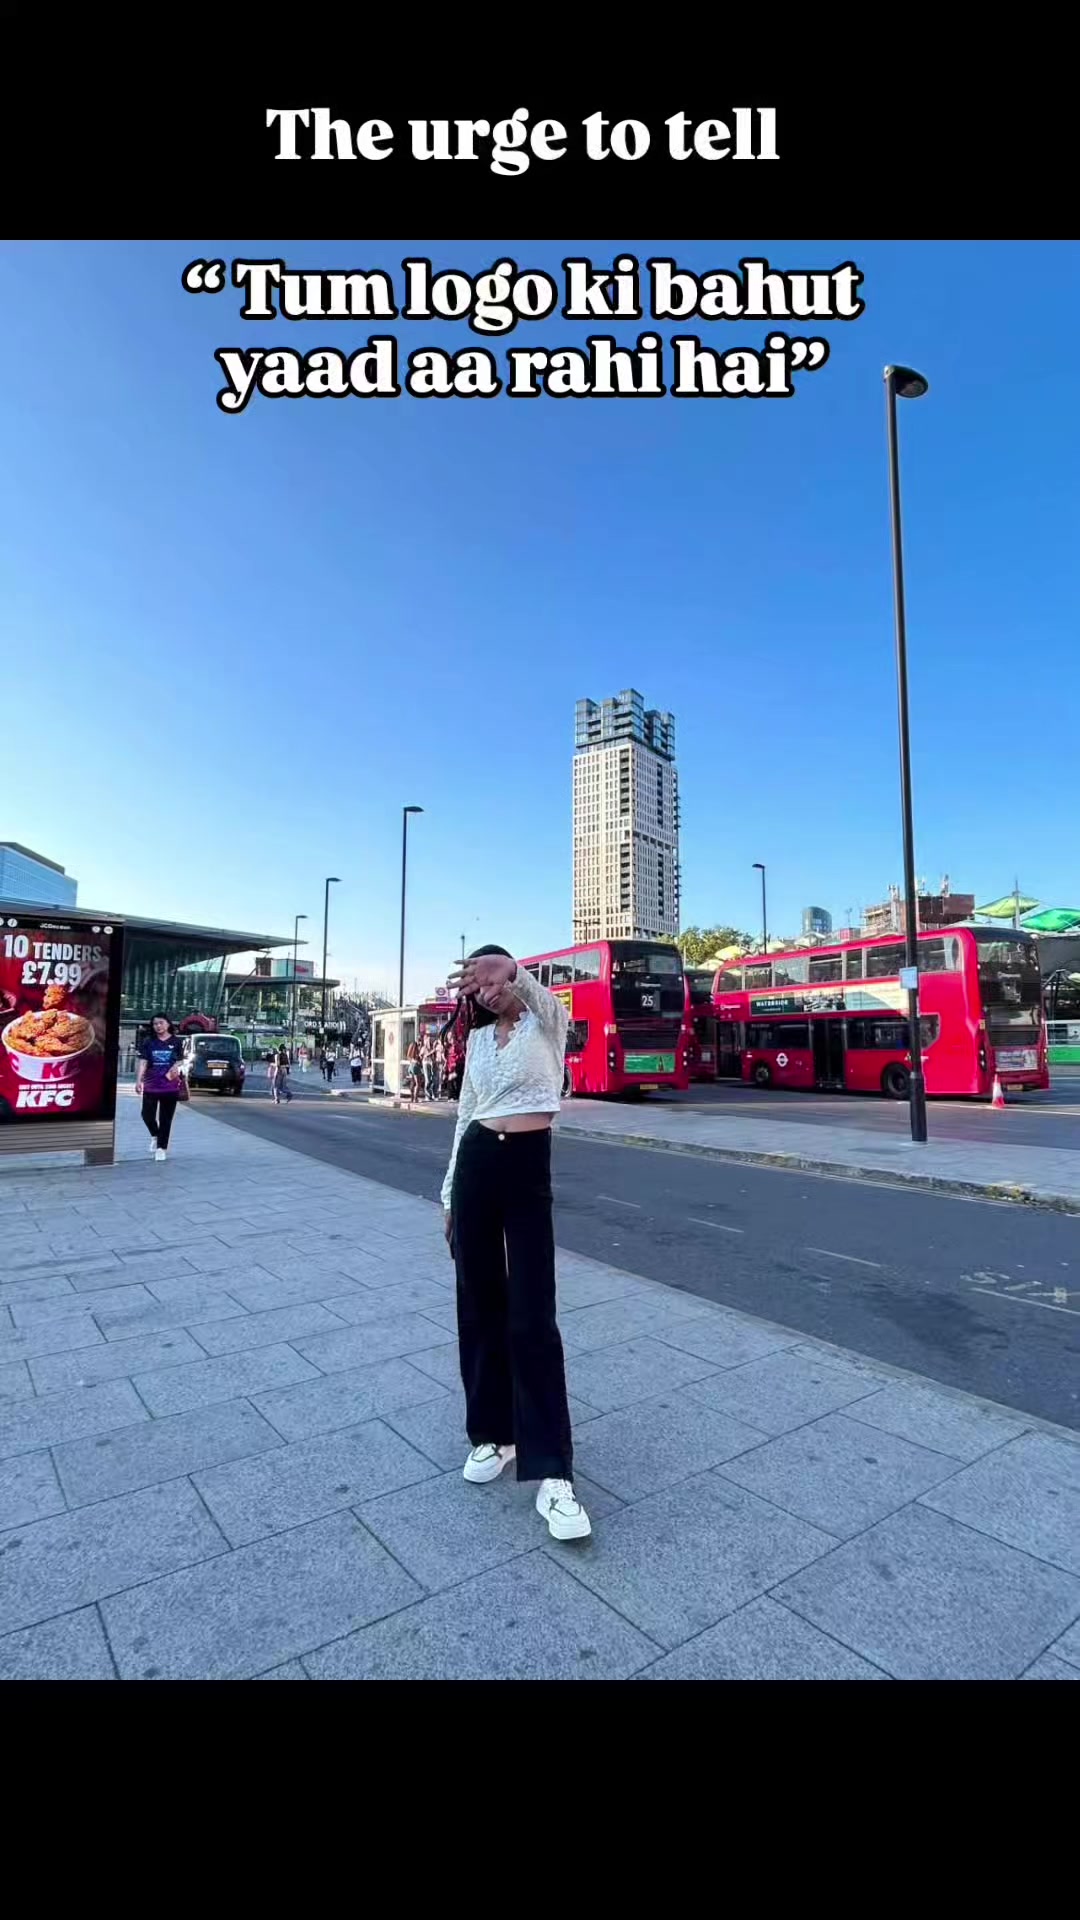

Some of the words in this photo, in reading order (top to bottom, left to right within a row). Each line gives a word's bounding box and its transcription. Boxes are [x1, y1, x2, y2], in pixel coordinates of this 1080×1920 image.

[4, 934, 29, 958] 10
[32, 941, 103, 962] TENDERS
[21, 960, 82, 987] £7.99
[641, 995, 654, 1007] 25
[16, 1090, 75, 1108] KFC
